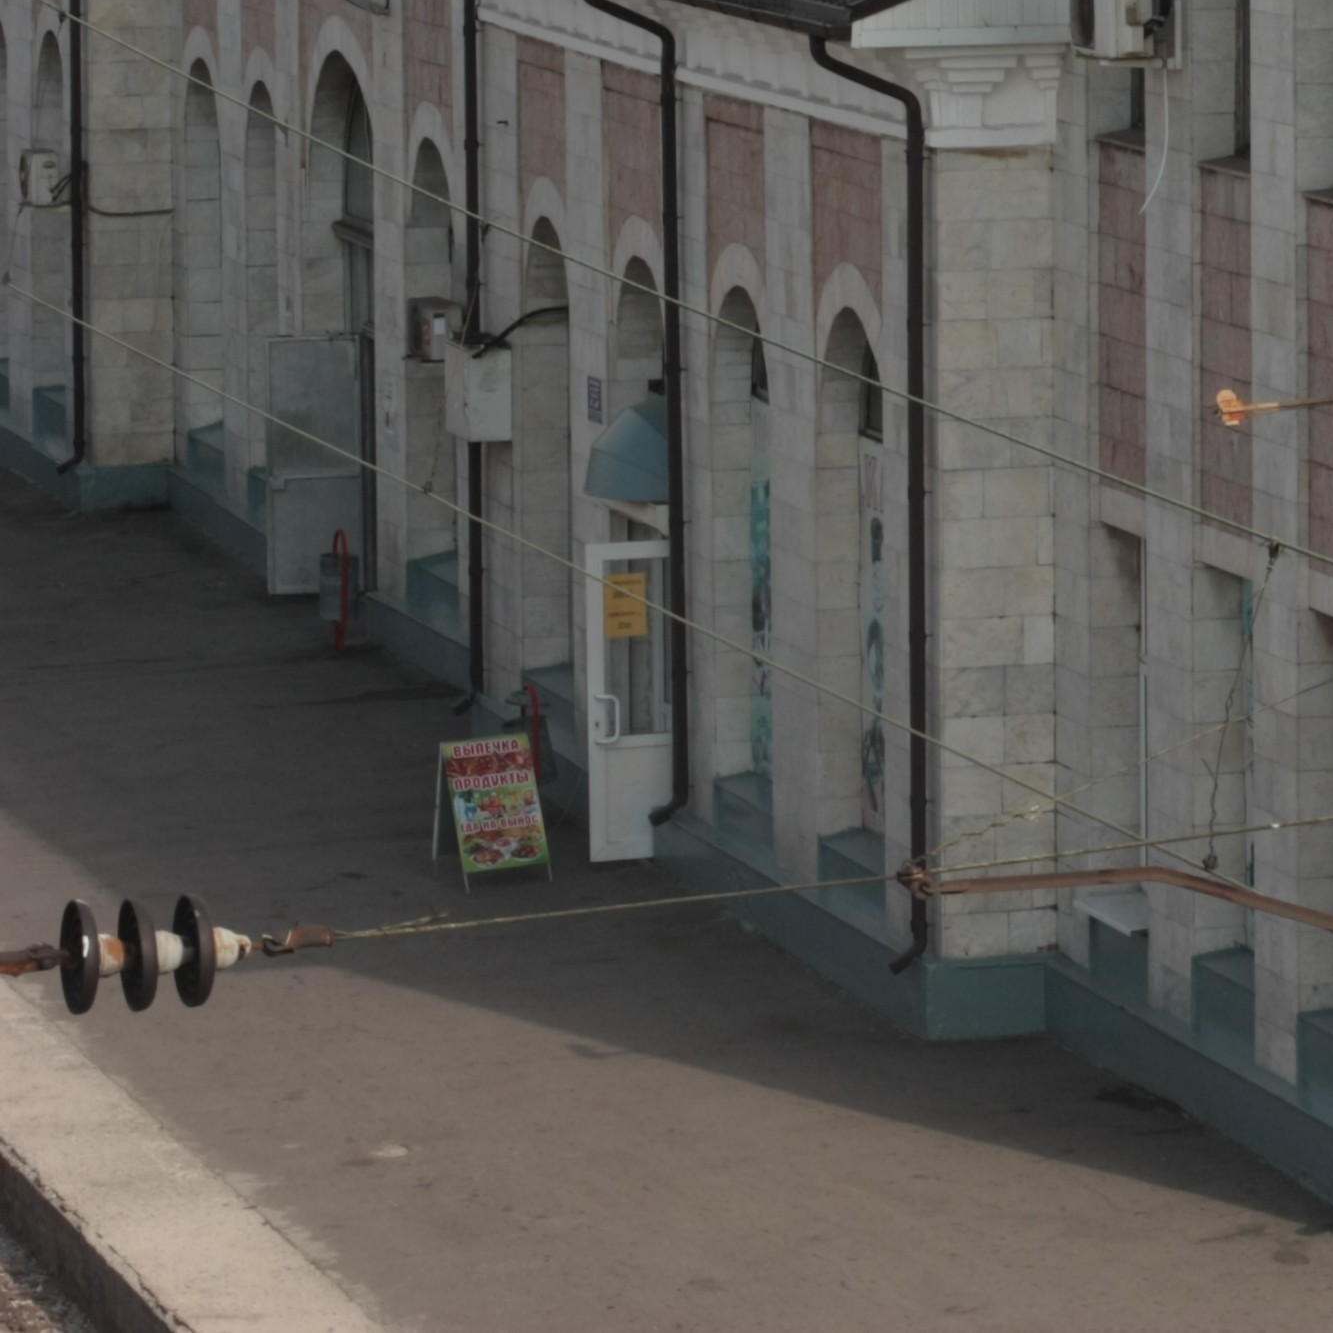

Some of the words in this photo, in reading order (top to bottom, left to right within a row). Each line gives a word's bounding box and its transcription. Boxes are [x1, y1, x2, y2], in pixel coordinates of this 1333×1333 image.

[453, 739, 519, 757] ВЫПЕЧКА
[454, 771, 529, 790] ПРОДУКТЫ
[483, 820, 497, 830] НА
[500, 815, 538, 827] ВЫНОС
